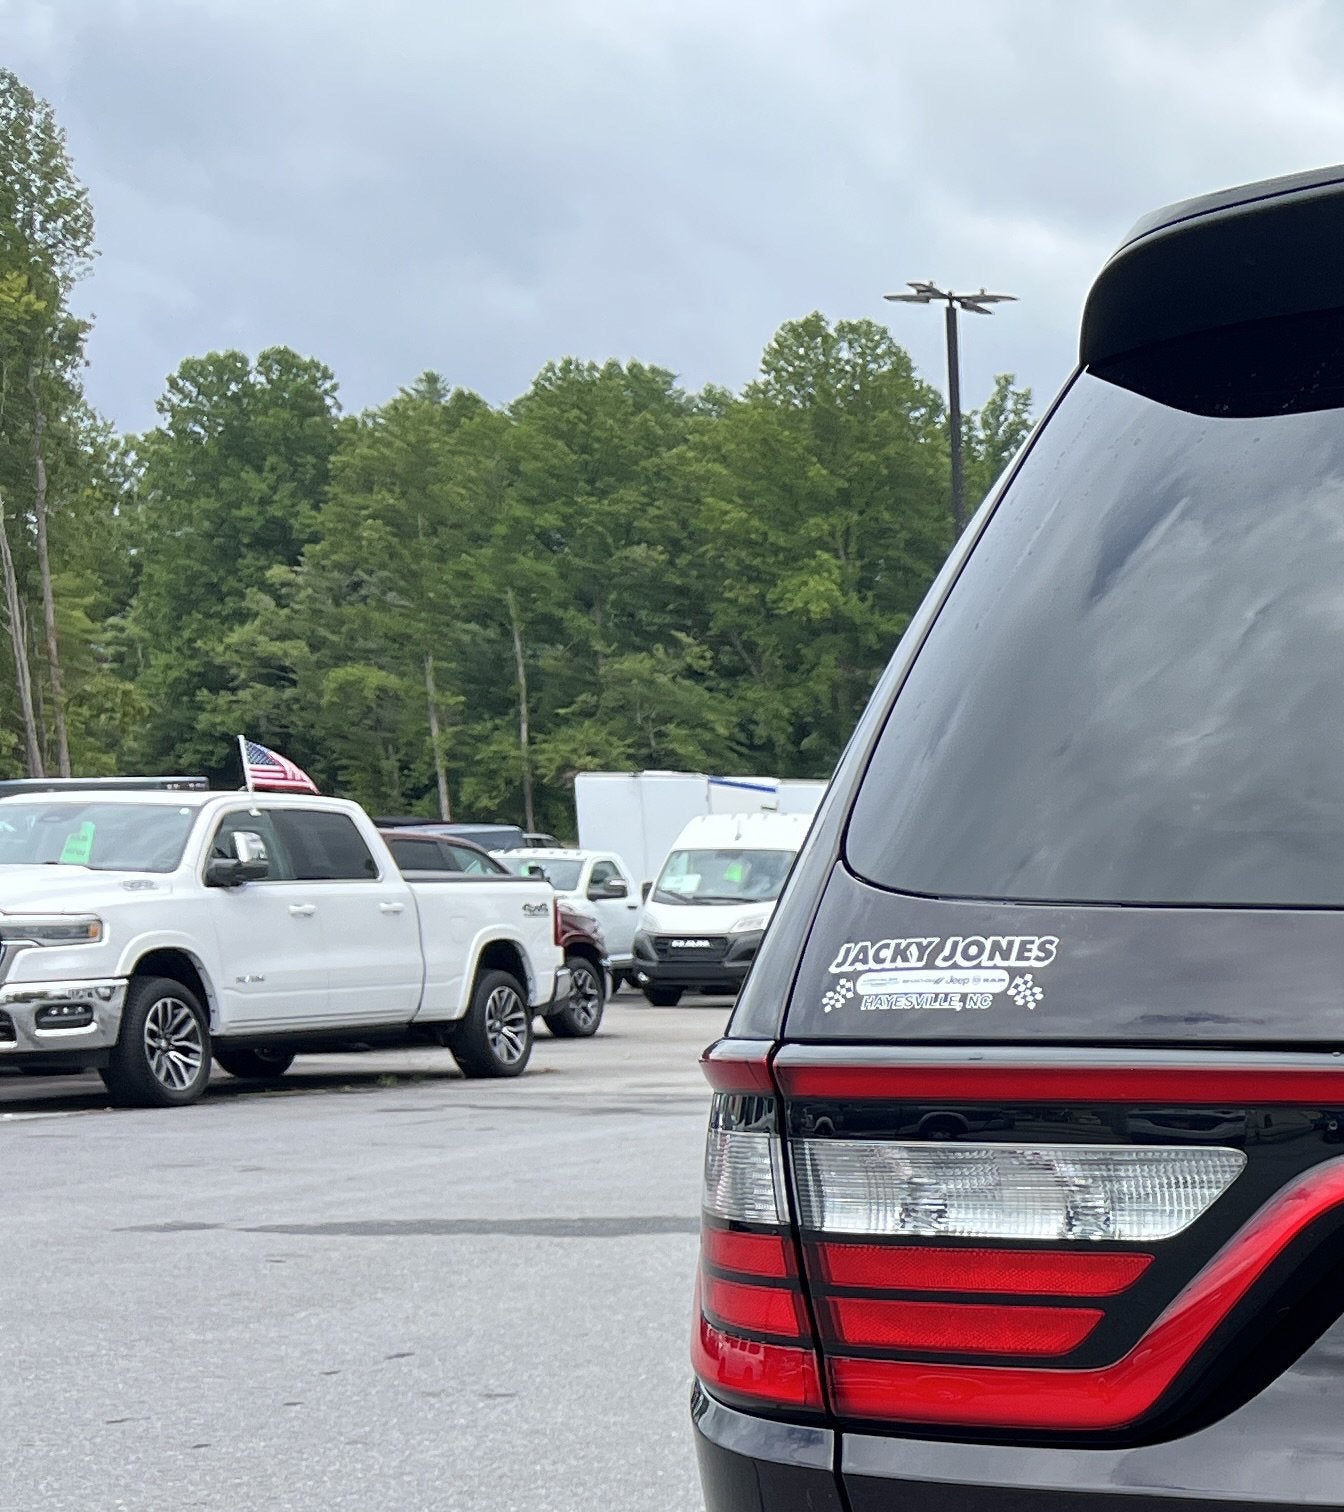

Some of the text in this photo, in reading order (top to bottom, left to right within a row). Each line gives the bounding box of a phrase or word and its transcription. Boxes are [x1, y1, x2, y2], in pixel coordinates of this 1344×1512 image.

[828, 936, 1060, 974] JACKY JONES
[861, 993, 994, 1011] HAYESVILLE, NC
